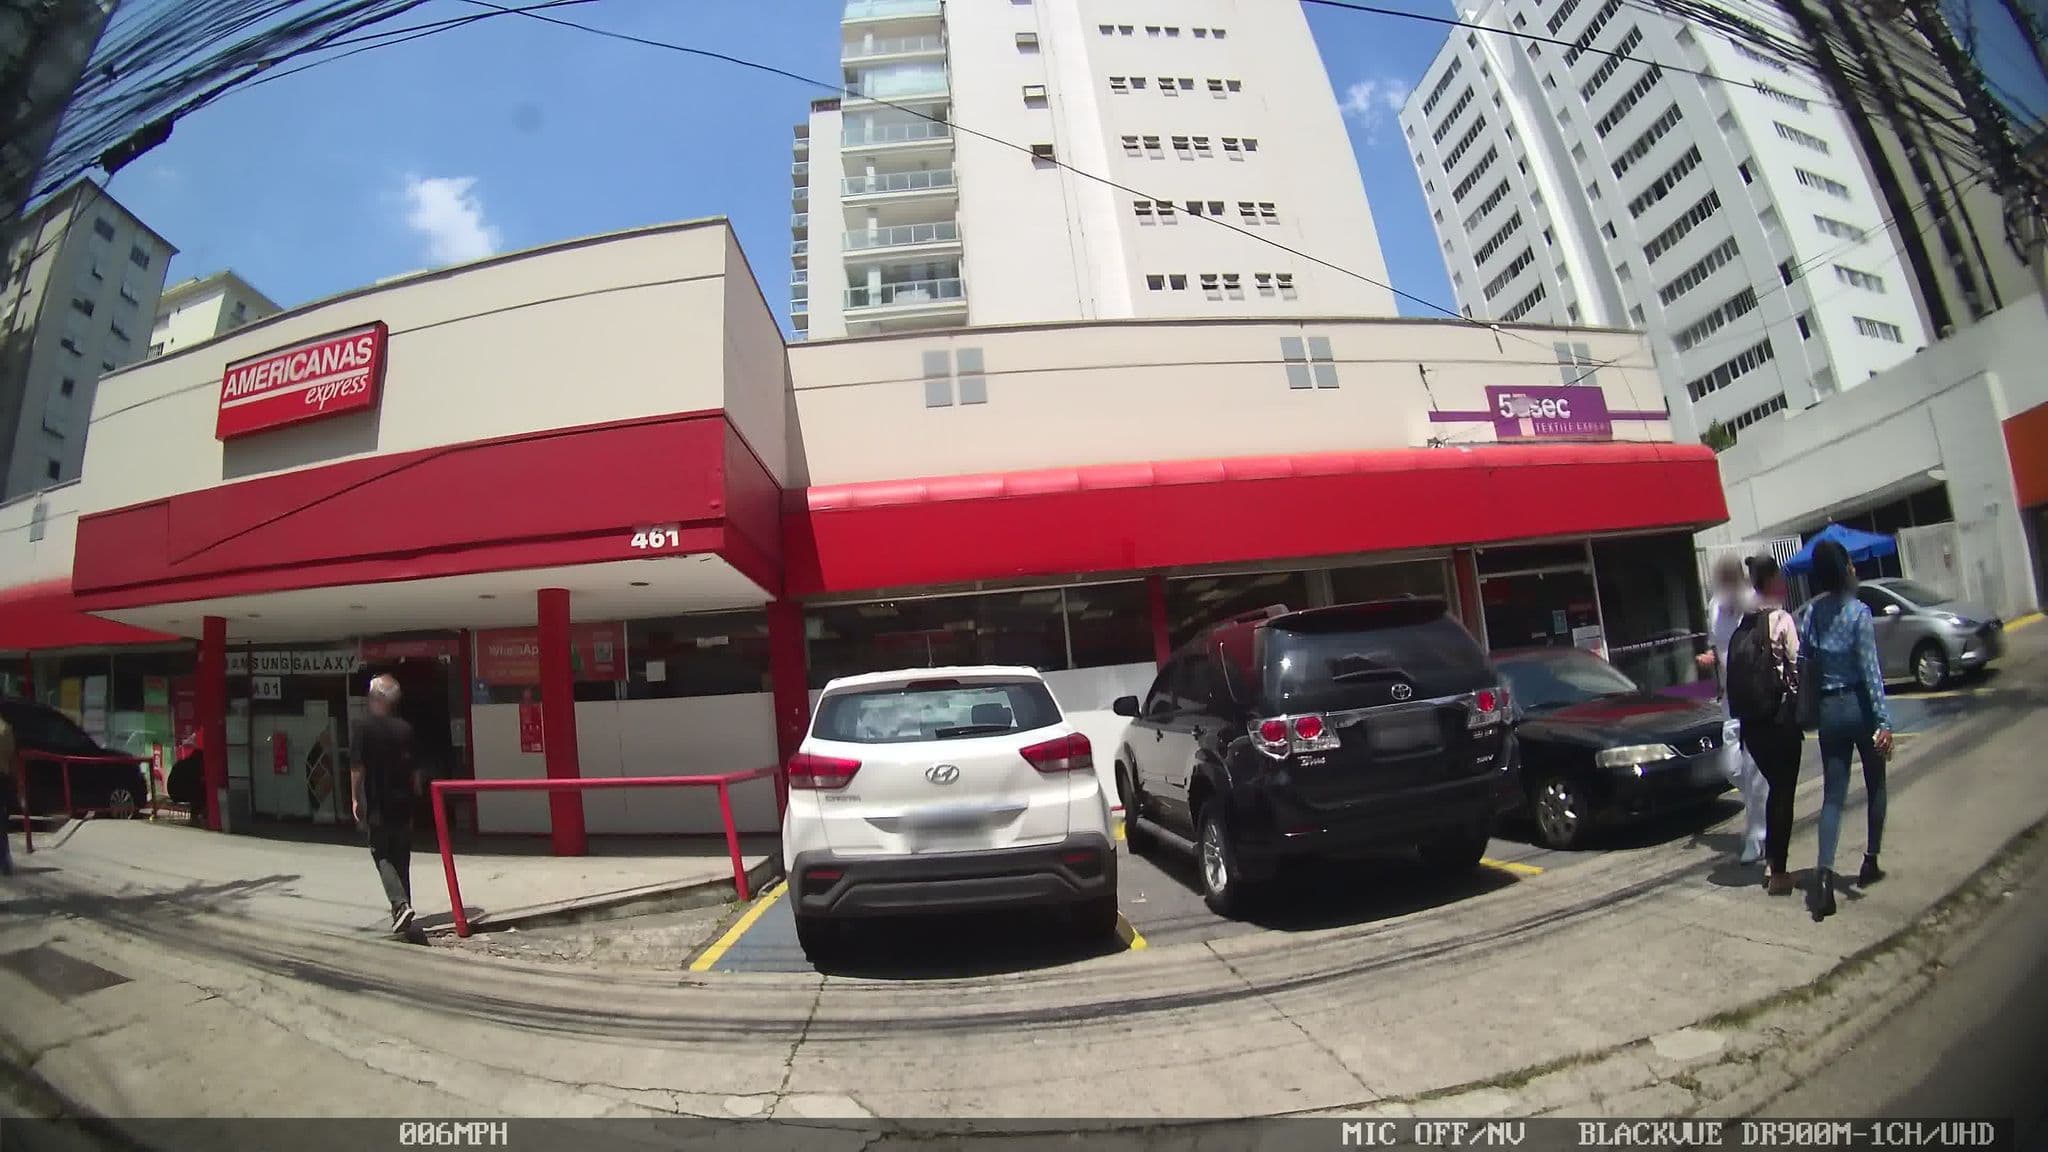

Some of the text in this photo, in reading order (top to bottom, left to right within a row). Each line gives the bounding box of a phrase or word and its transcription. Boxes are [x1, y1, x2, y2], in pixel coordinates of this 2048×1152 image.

[223, 336, 373, 399] AMERICANAS
[304, 373, 369, 410] express
[1498, 393, 1571, 419] 5sec
[630, 527, 680, 549] 461
[293, 655, 355, 671] GALAXY
